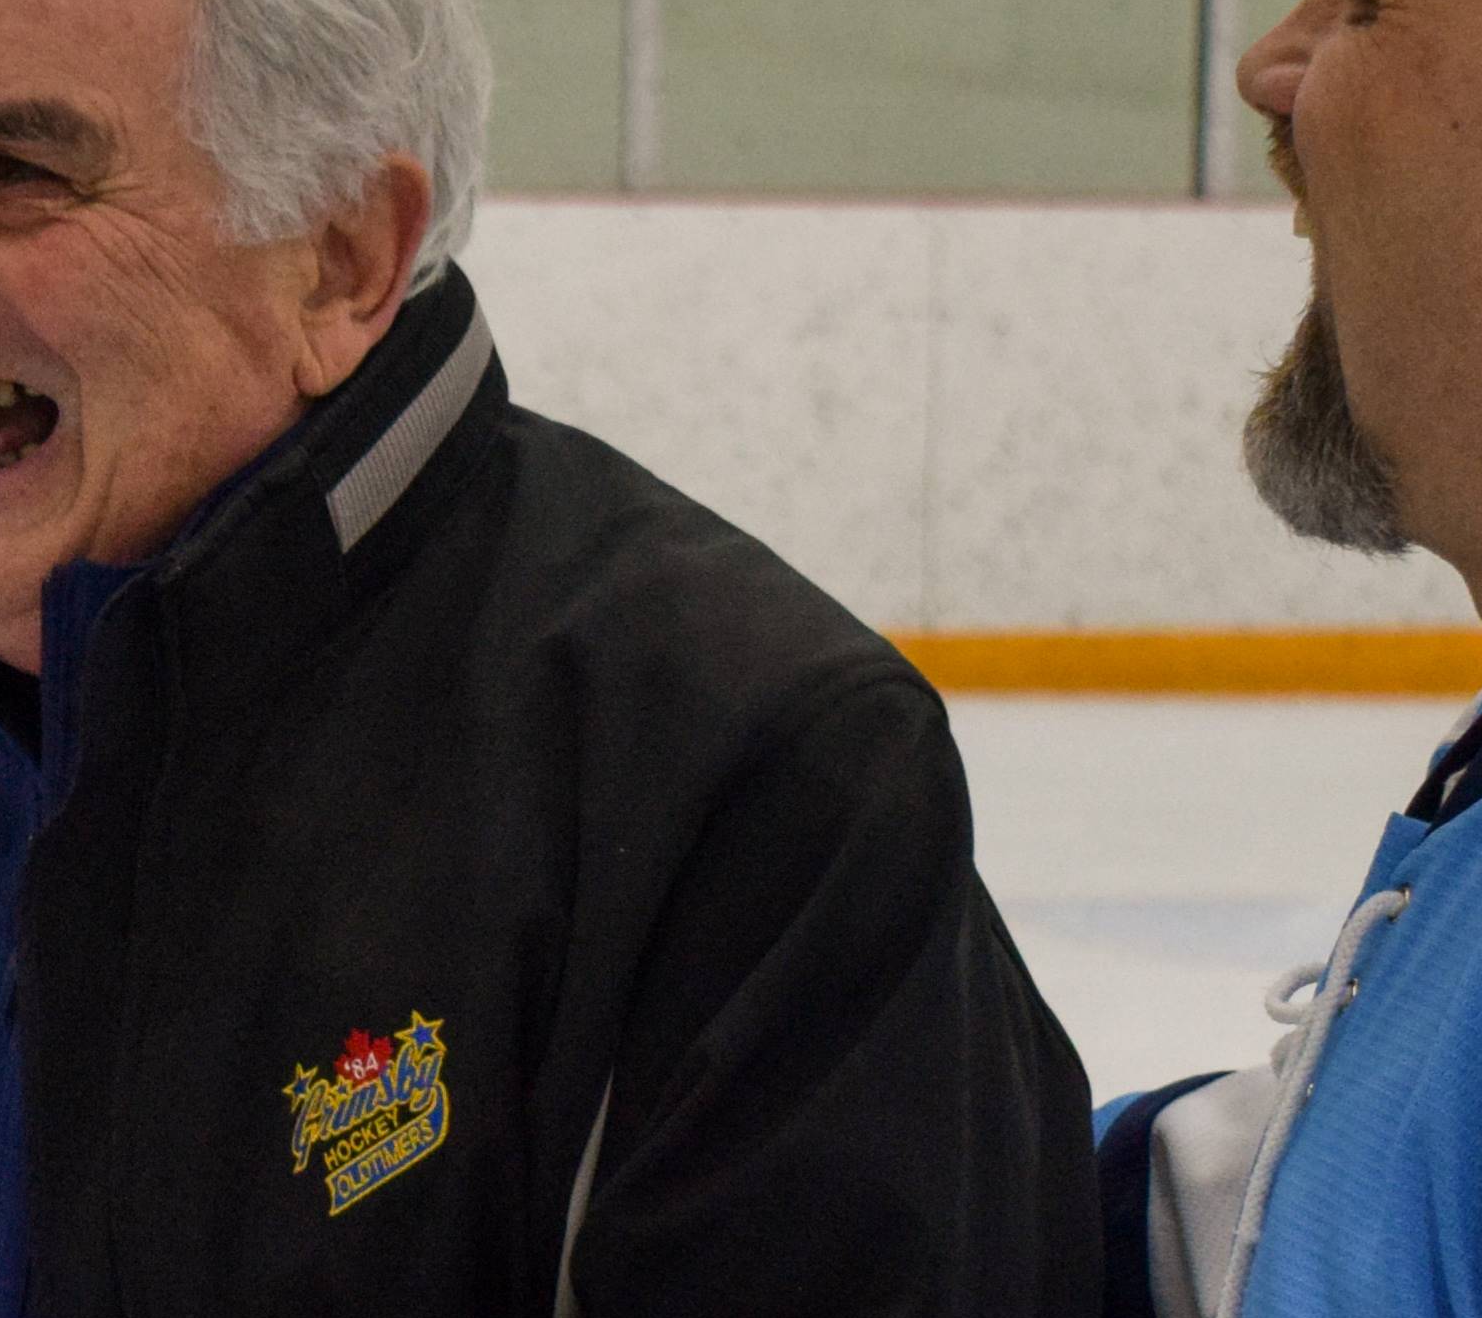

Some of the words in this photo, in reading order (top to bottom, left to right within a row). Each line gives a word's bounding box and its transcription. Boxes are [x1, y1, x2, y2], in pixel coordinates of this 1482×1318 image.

[292, 1043, 445, 1174] Grimsby
[324, 1106, 399, 1170] HOCKEY
[336, 1118, 434, 1198] OLDTIMERS
